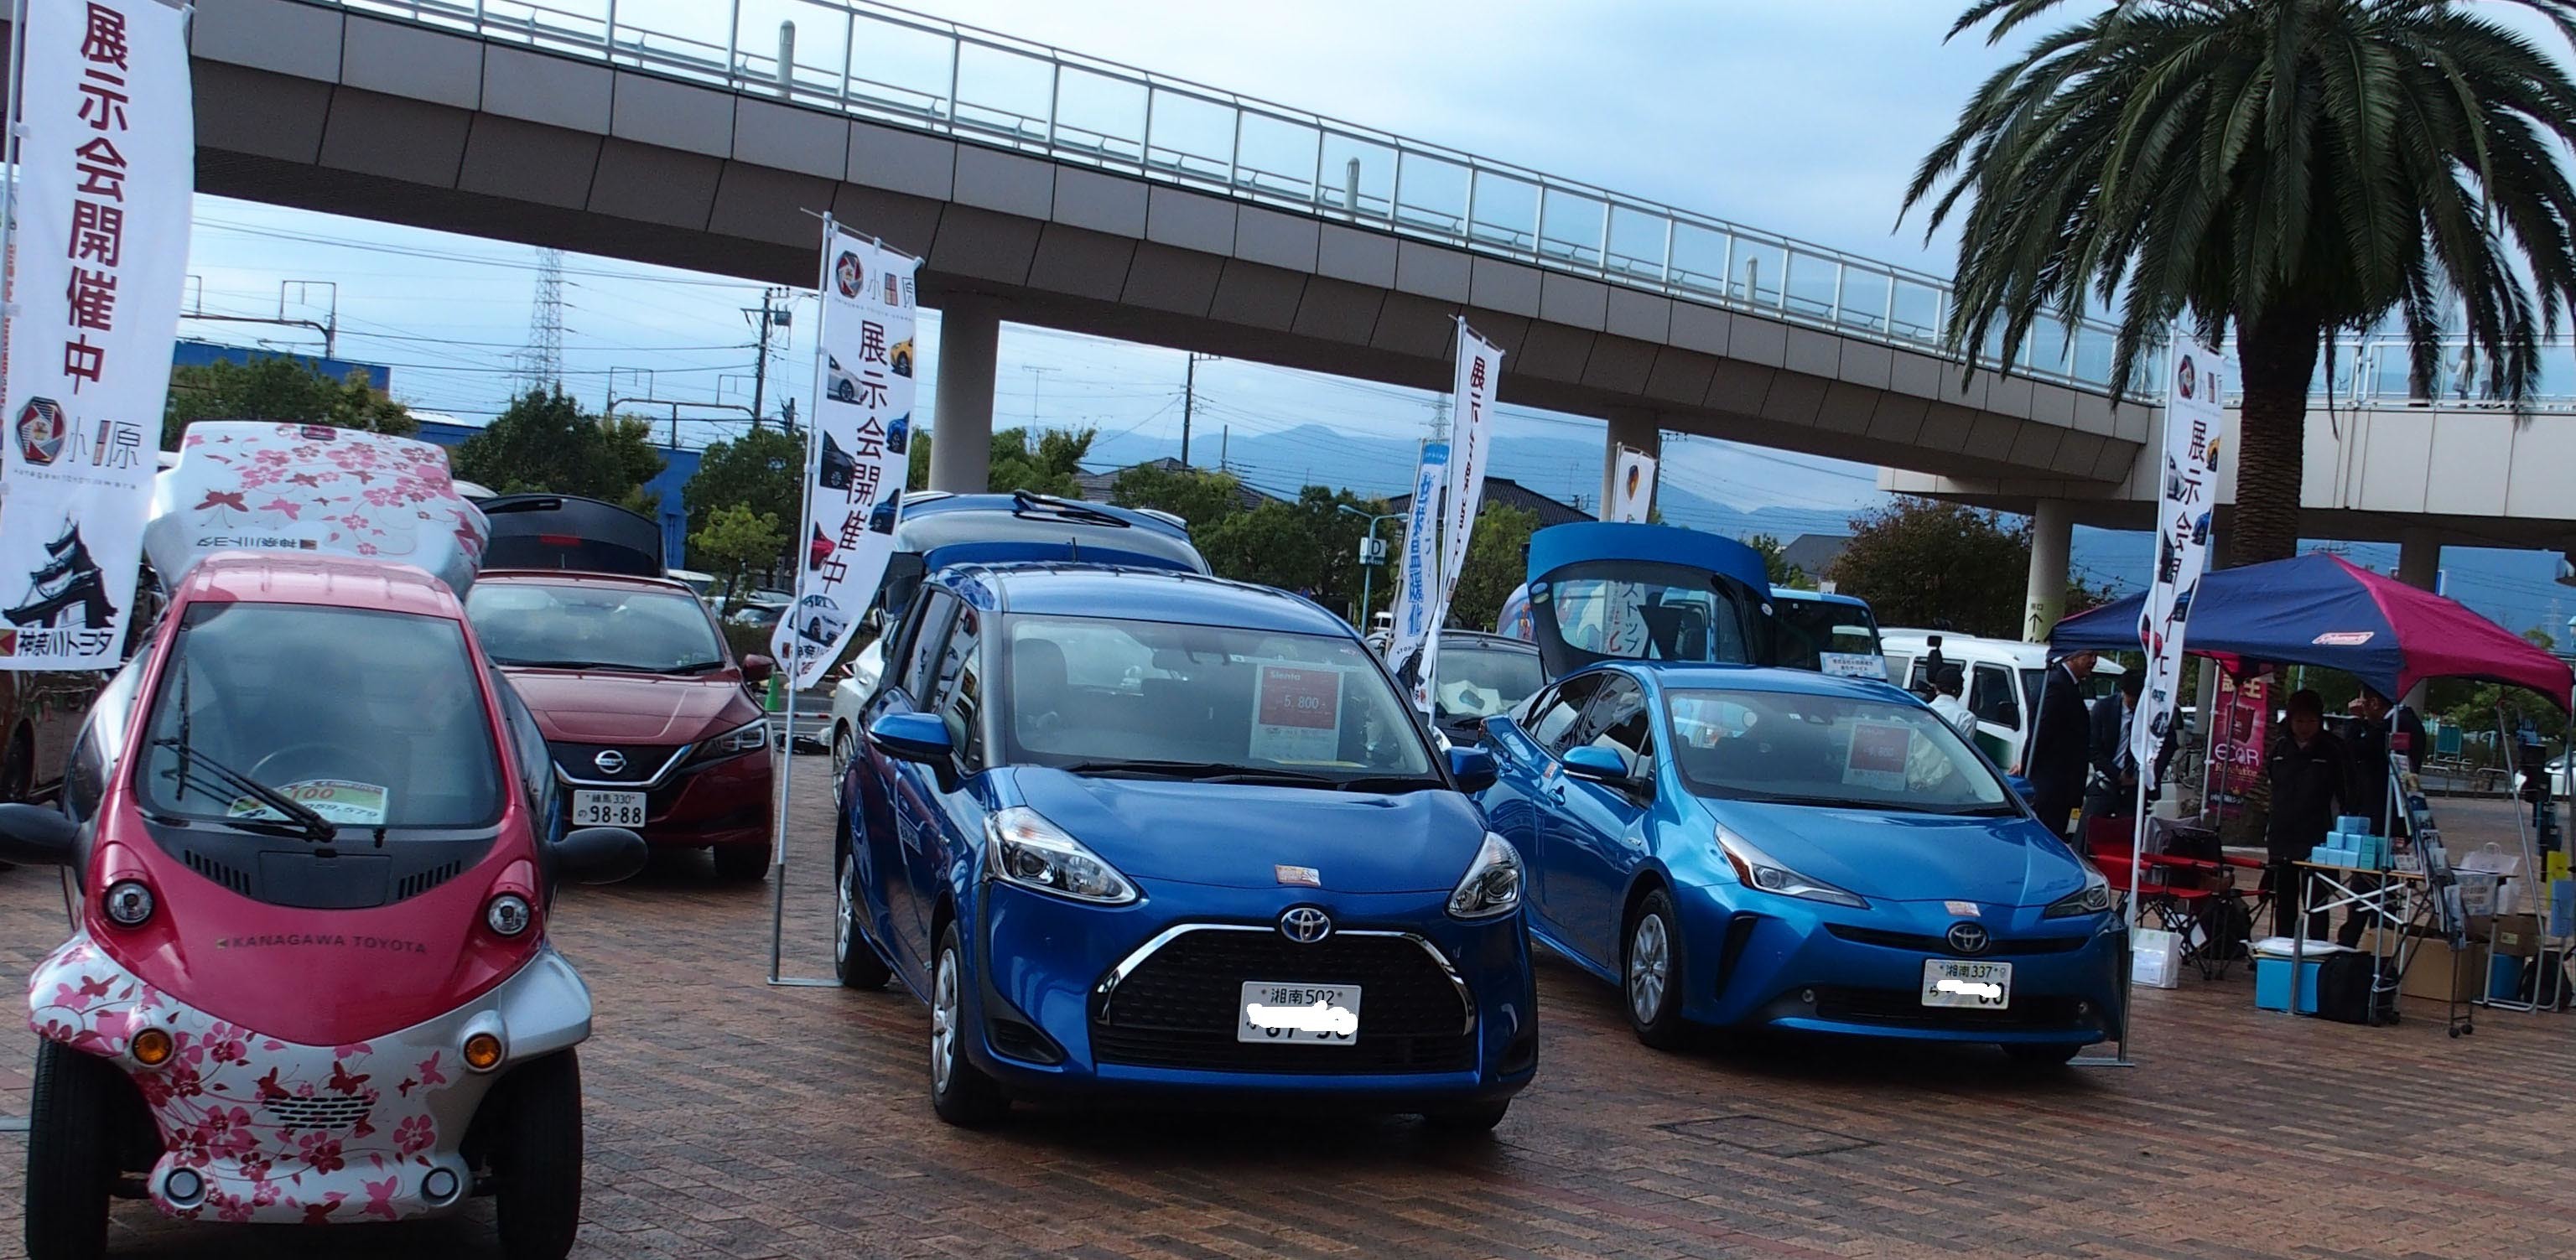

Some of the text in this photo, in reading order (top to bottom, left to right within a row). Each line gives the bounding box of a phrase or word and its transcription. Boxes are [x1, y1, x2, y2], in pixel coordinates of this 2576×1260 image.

[63, 3, 129, 395] 展示会開催中
[822, 320, 888, 594] 展示会開催中
[1371, 540, 1381, 555] D
[589, 805, 641, 824] 98-88
[231, 934, 427, 953] KANAGAWA TOYOTA
